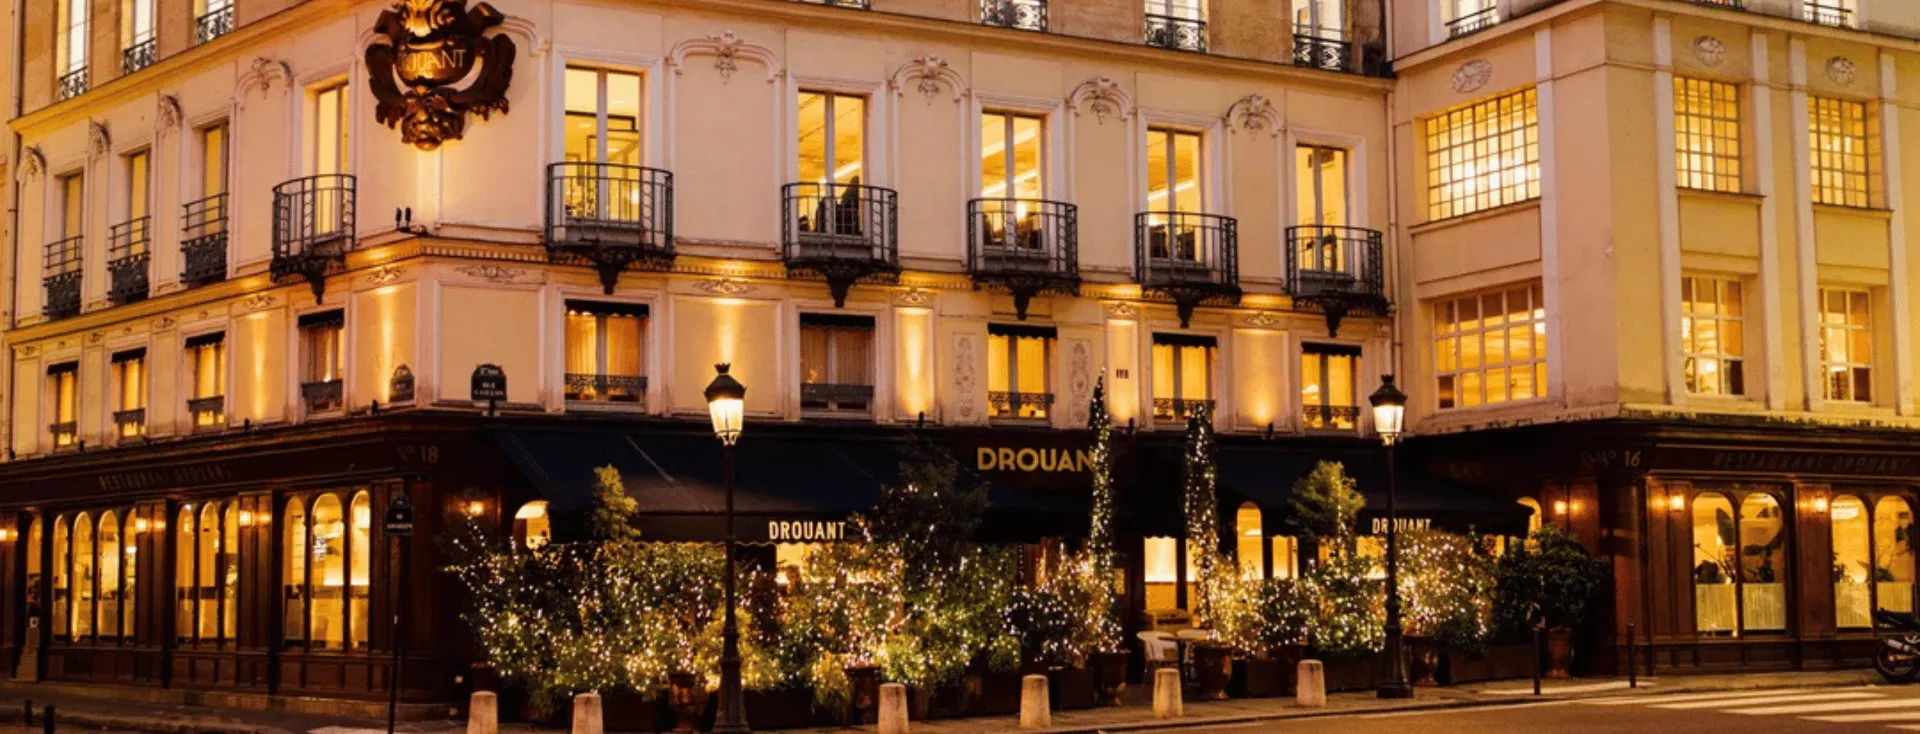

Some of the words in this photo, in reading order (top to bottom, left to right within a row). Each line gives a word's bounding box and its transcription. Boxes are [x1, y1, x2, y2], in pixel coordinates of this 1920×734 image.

[420, 444, 439, 464] 18
[976, 446, 1094, 473] DROUAN
[1623, 449, 1642, 467] 16
[768, 520, 846, 540] DROUANT
